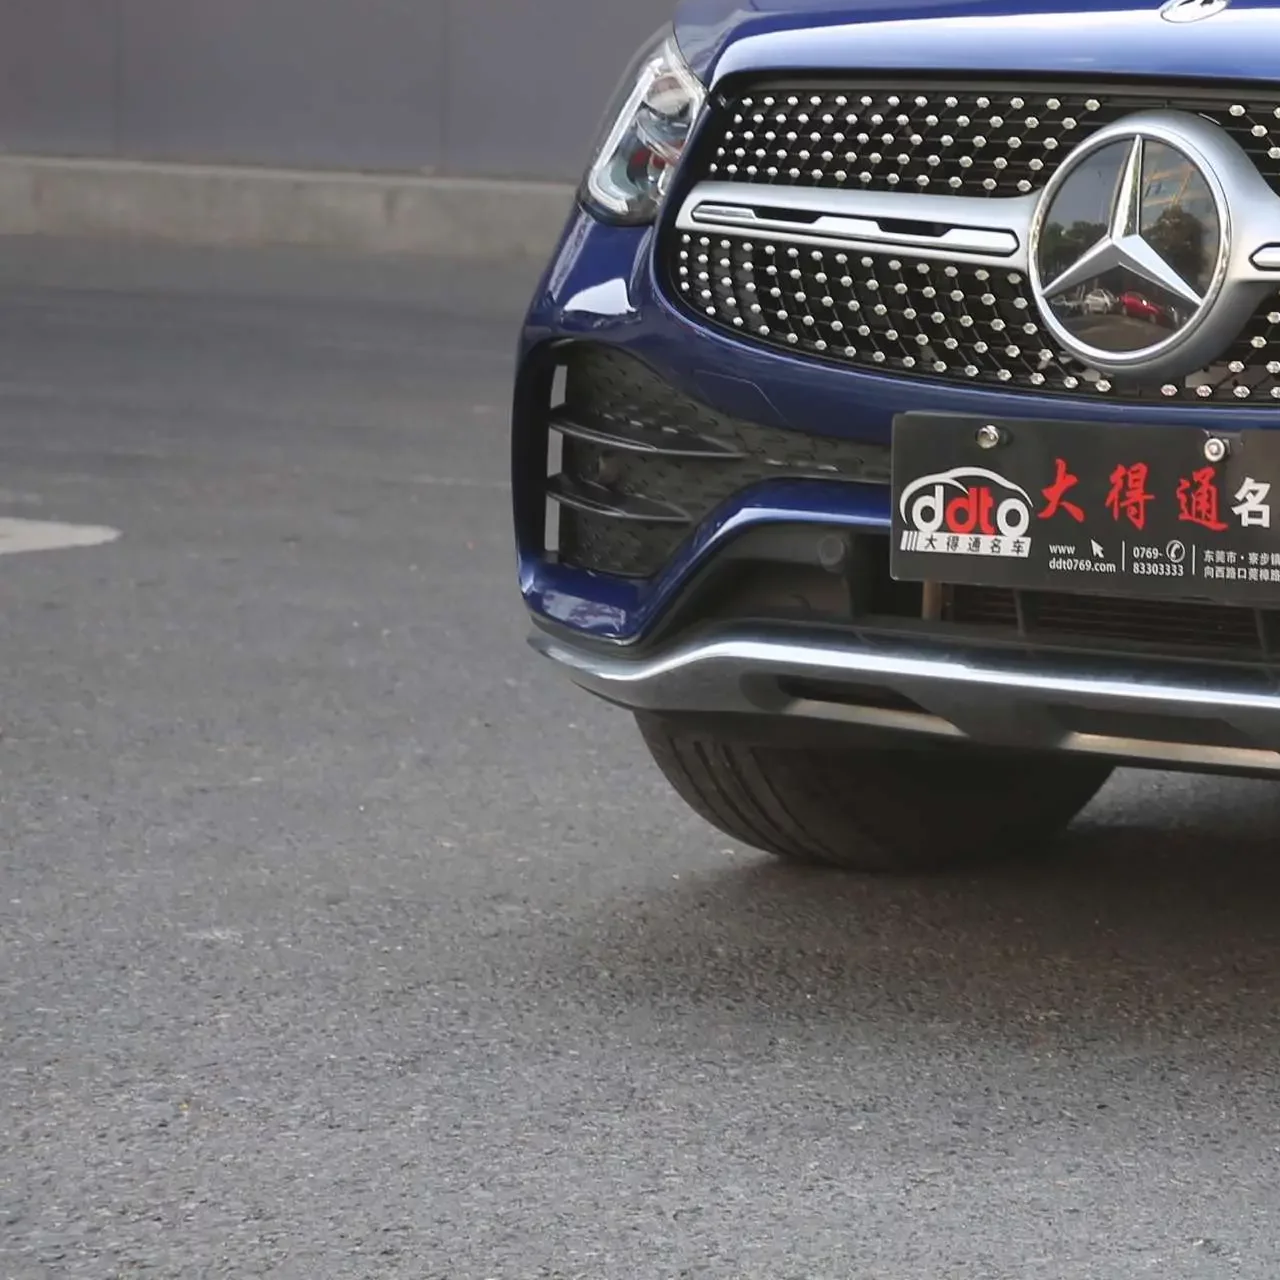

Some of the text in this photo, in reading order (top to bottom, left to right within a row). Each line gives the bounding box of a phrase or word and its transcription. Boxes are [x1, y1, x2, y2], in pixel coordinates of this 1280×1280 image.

[924, 535, 1026, 555] 大得通名车
[1048, 544, 1076, 555] www
[1132, 546, 1164, 560] 0769-
[1048, 557, 1117, 573] ddt0769.com
[1132, 562, 1184, 577] 83303333
